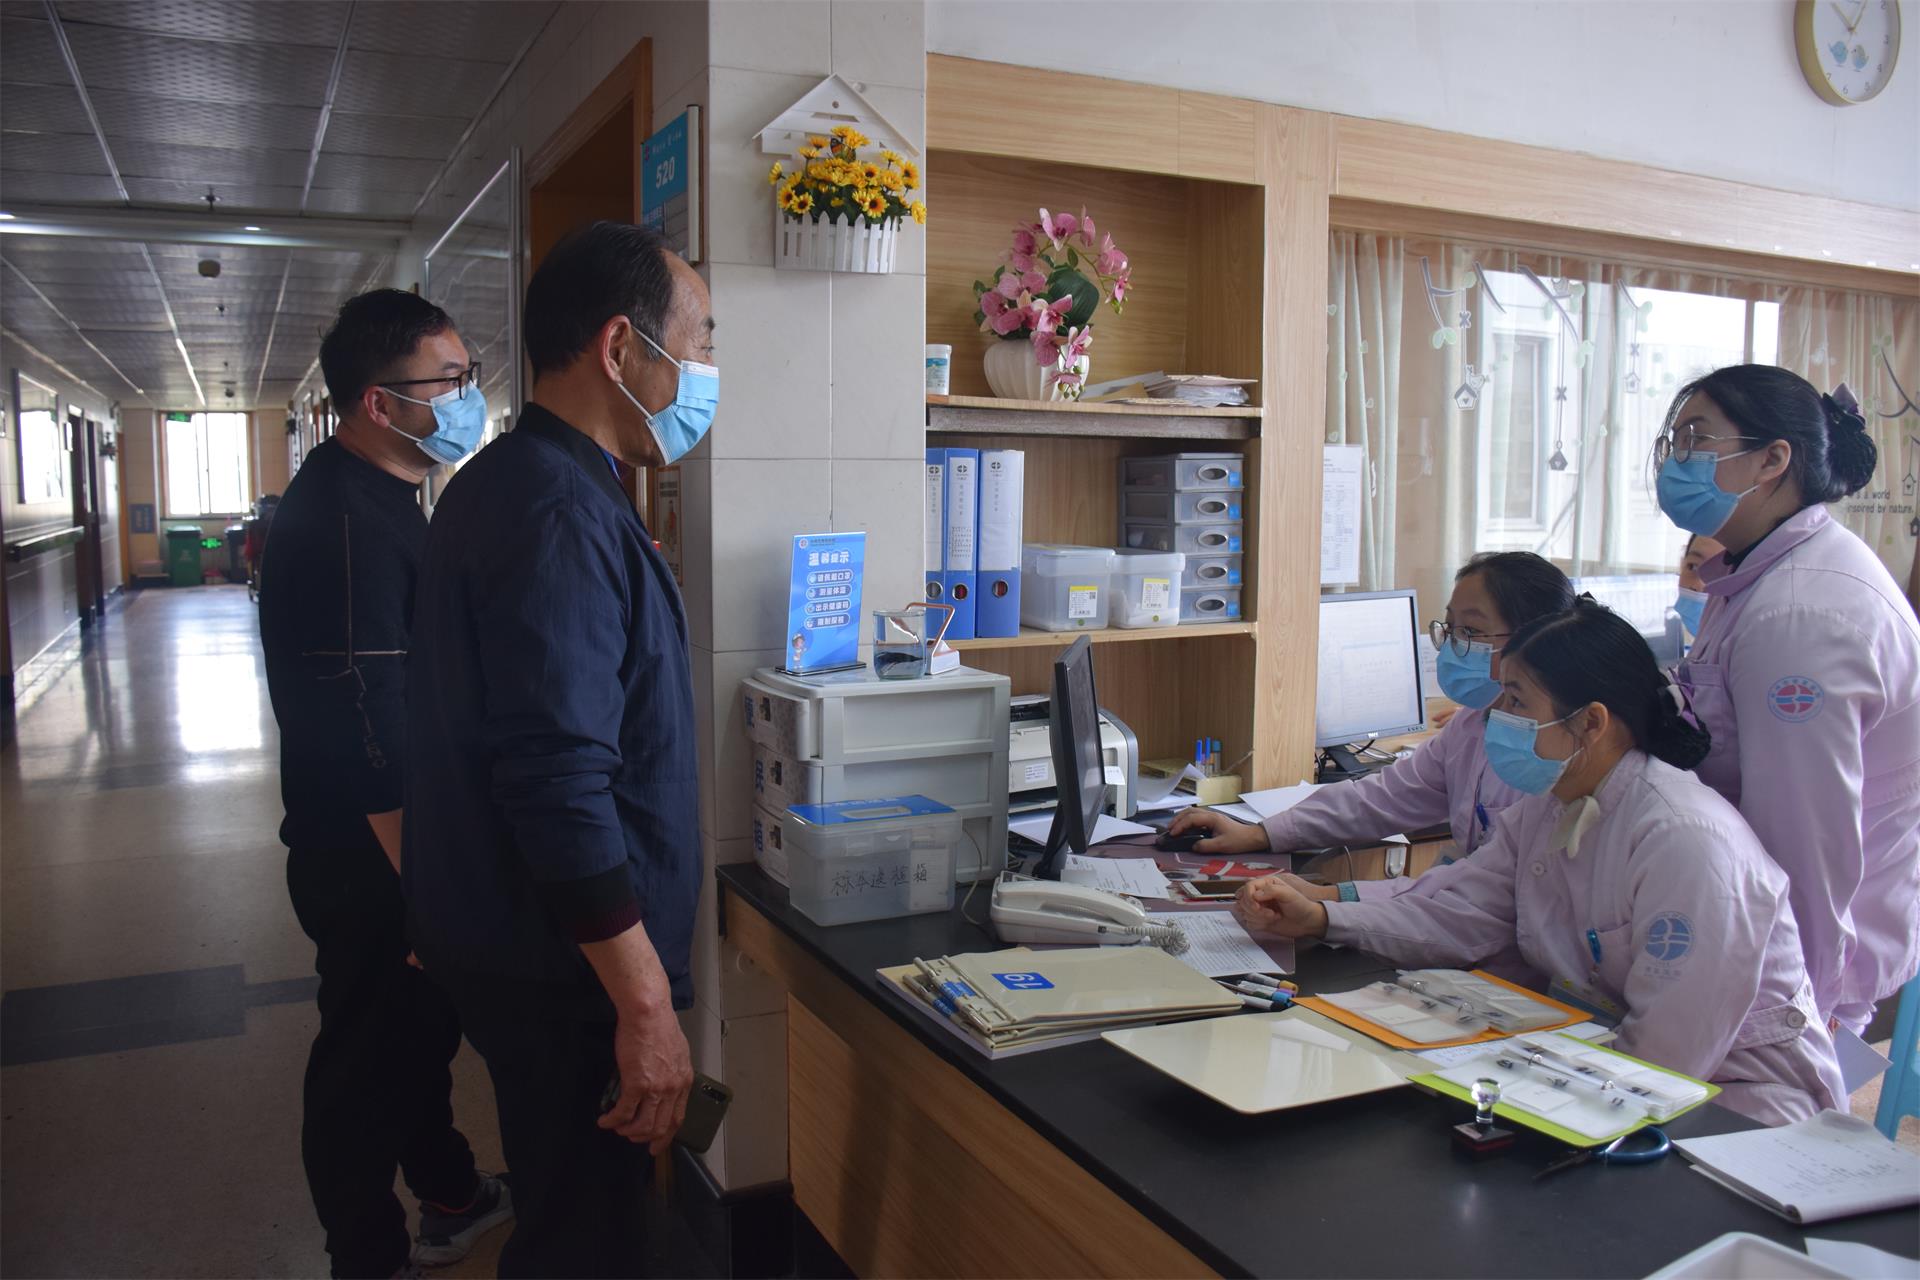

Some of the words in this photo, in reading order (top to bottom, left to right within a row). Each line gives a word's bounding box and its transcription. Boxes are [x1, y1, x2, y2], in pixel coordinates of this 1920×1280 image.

[655, 156, 675, 190] 520
[1872, 489, 1890, 500] world
[1877, 503, 1886, 514] by
[808, 551, 850, 566] 温馨提示
[1003, 974, 1043, 989] 19
